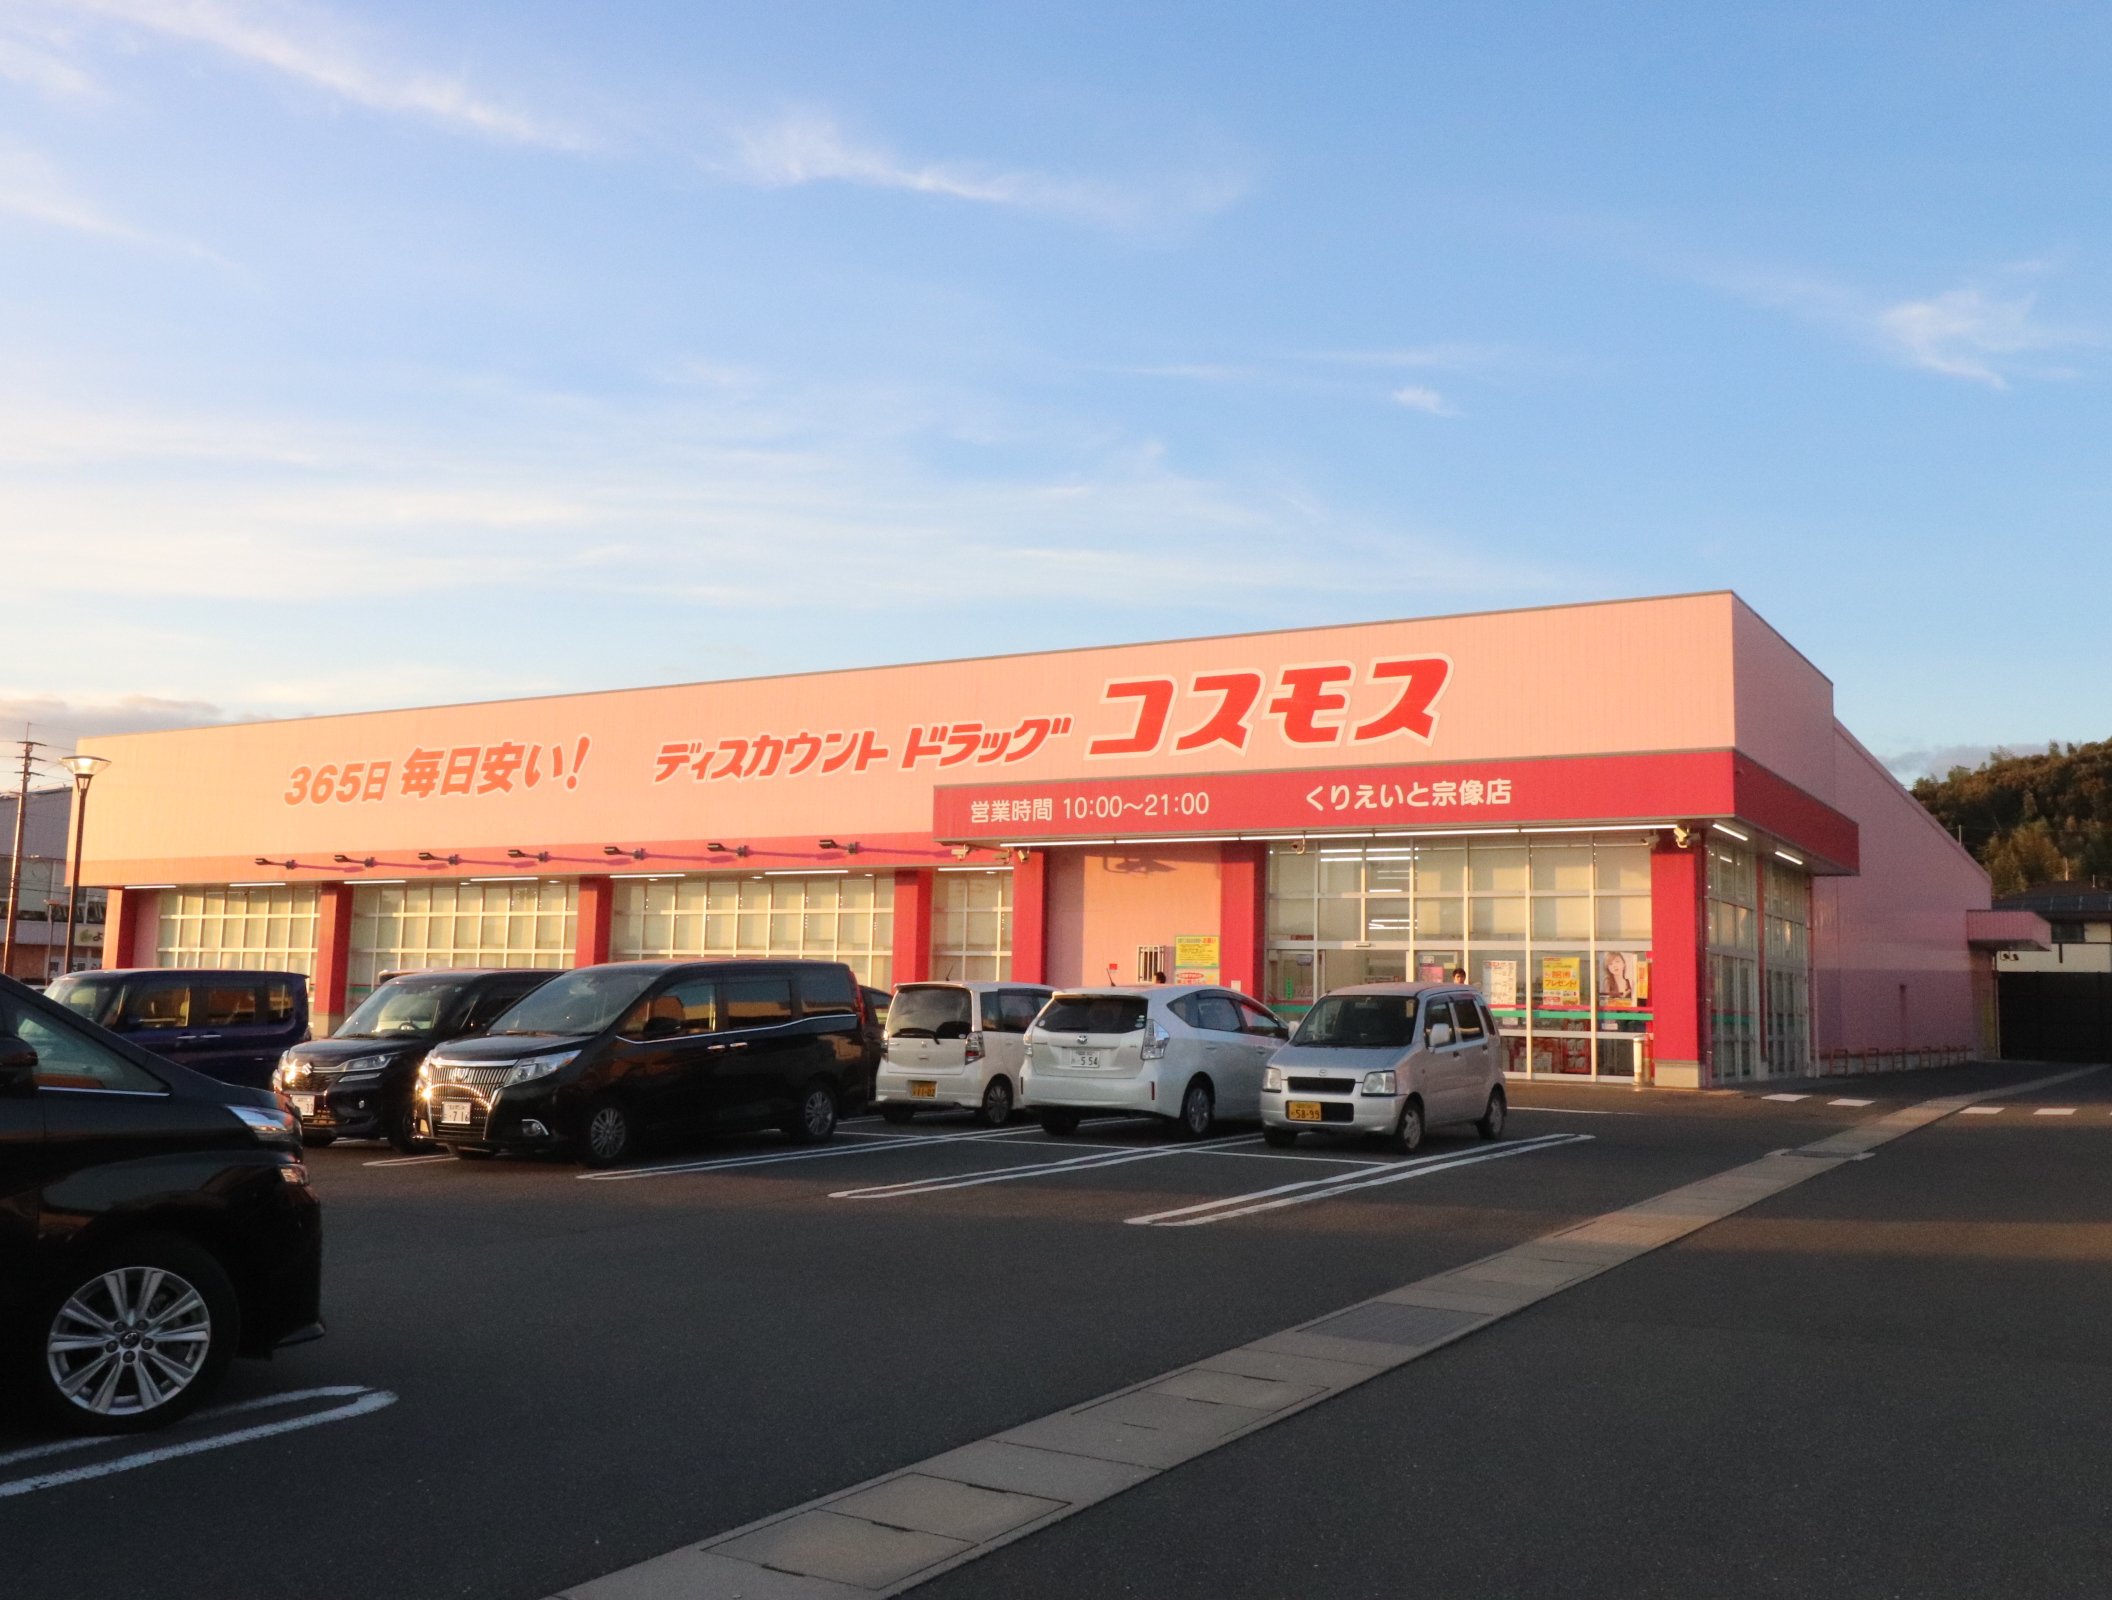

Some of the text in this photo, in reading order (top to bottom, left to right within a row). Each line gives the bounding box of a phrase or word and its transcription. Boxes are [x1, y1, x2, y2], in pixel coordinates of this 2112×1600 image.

[1089, 657, 1449, 756] コスモス
[655, 716, 1072, 783] ディスカウント ドラッグ
[285, 760, 392, 806] 365日
[1306, 778, 1512, 812] くりえいと宗像店
[970, 798, 1053, 824] 営業時間
